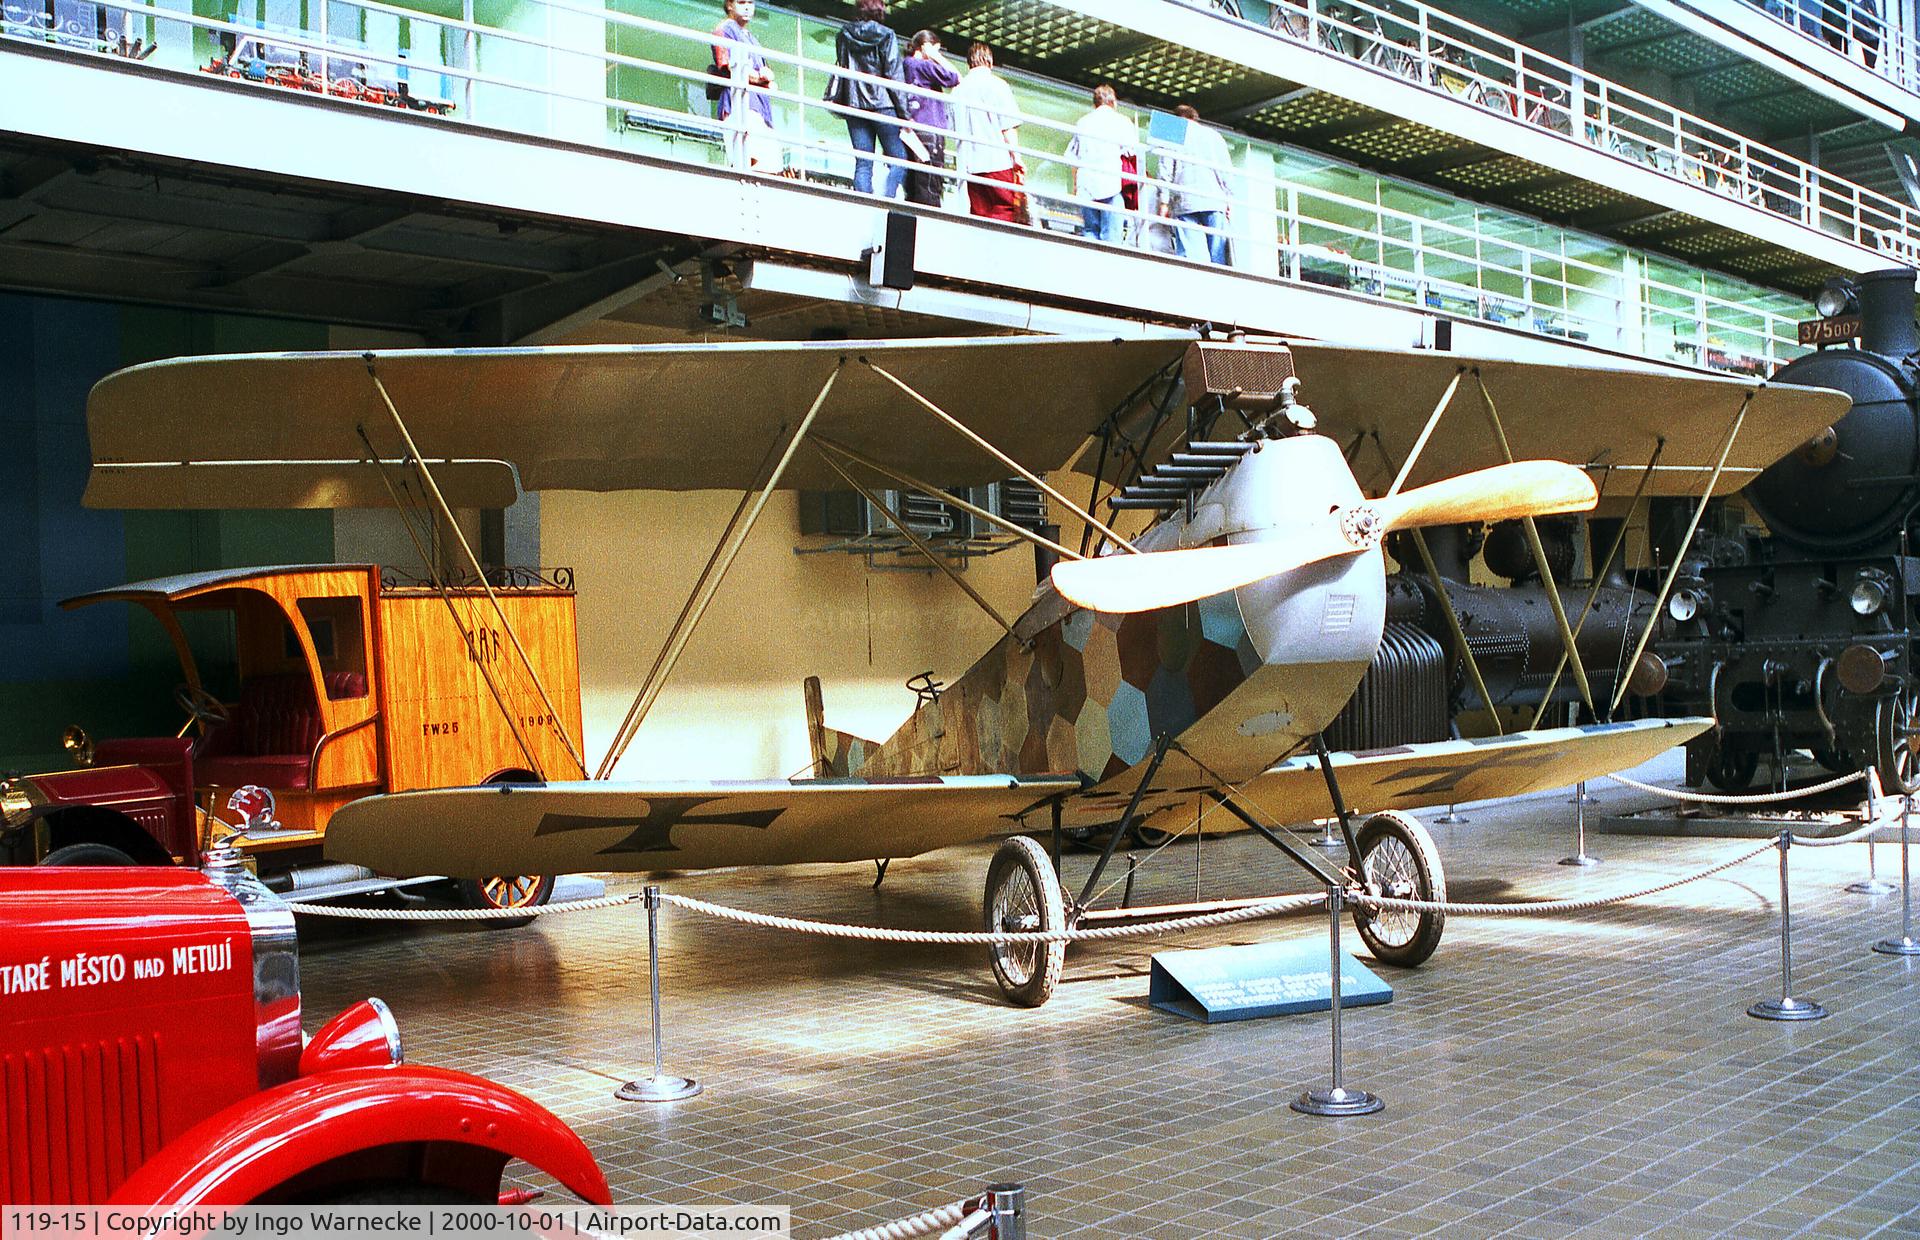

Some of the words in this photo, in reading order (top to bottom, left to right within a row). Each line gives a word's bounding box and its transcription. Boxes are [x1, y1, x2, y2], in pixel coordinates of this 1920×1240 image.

[423, 721, 459, 736] FW25
[0, 956, 51, 995] TARÉ
[60, 953, 126, 988] MĚSTO
[133, 957, 165, 980] NAD
[172, 936, 232, 976] METUJÍ
